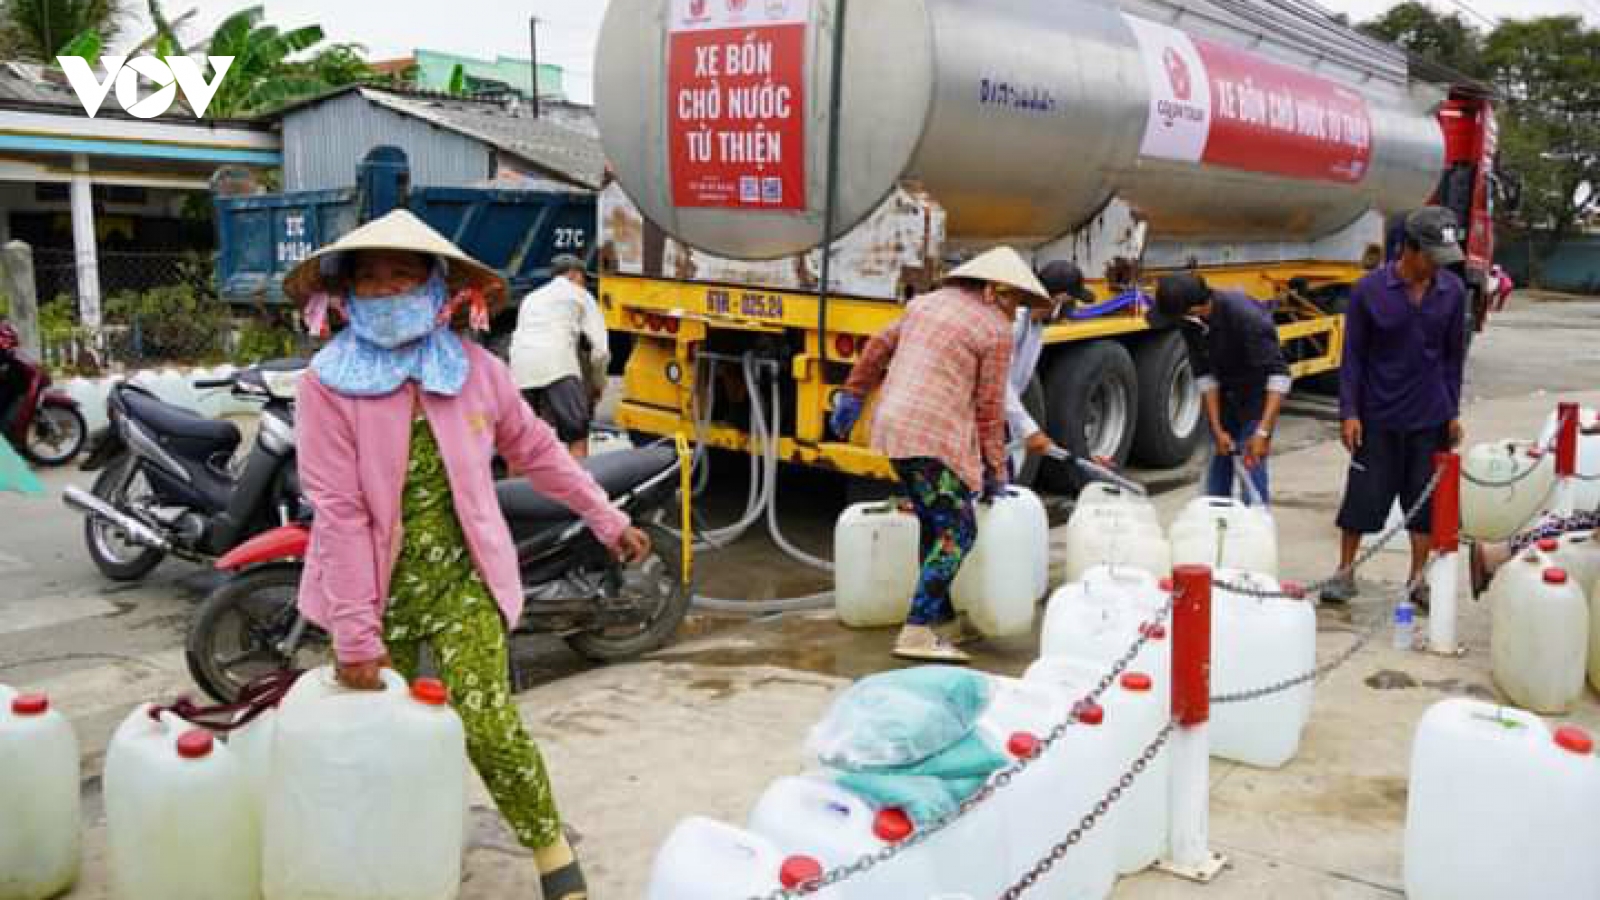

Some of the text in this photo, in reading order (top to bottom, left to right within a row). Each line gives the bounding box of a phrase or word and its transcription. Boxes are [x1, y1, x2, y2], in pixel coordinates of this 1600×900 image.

[695, 45, 720, 78] XE
[728, 77, 792, 119] NƯỚC
[687, 121, 782, 172] TỪ THIỆN
[554, 227, 584, 248] 27C
